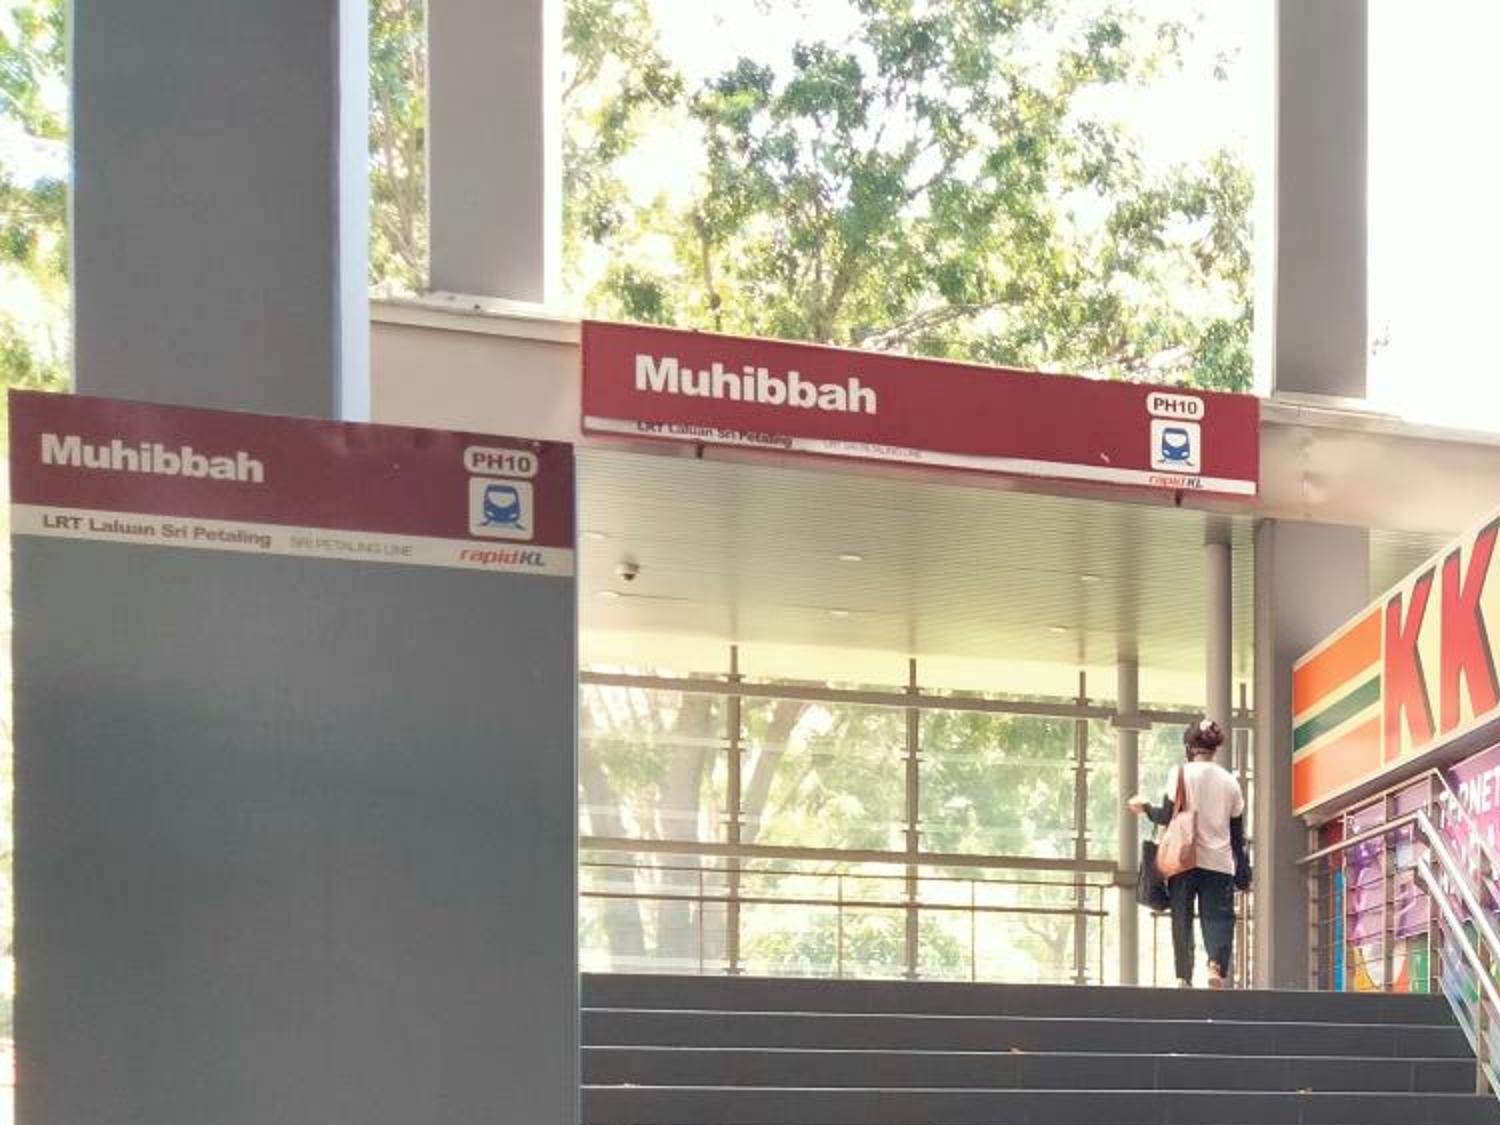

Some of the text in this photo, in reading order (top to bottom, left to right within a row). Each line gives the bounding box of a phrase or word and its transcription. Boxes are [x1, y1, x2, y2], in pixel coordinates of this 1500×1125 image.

[635, 353, 877, 415] Muhibbah
[1153, 397, 1197, 415] PH10
[637, 420, 664, 432] LRT
[41, 433, 264, 483] Muhibbah
[472, 452, 531, 473] PH10
[43, 514, 272, 549] LRT Laluan Sri Petaling
[458, 549, 545, 567] rapidKL
